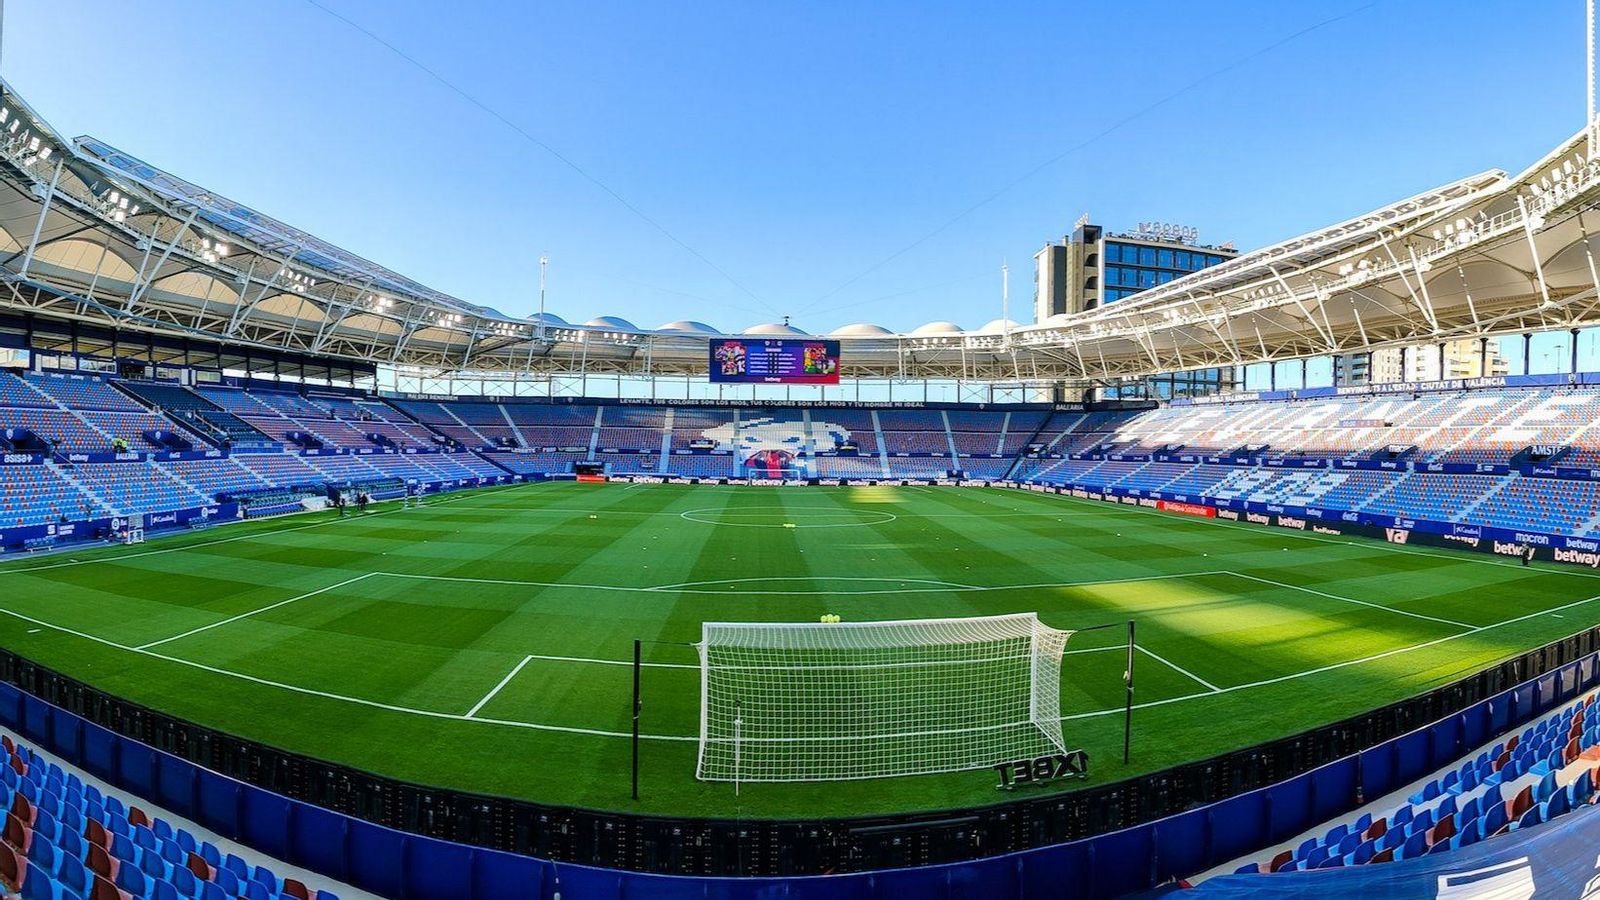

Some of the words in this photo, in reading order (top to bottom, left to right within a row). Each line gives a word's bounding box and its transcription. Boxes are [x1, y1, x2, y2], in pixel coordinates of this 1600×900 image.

[1421, 381, 1448, 390] CIUTAT
[1449, 379, 1463, 388] DE
[1464, 376, 1505, 387] VALÈNCIA
[1278, 516, 1306, 530] betway
[1515, 532, 1549, 544] macron
[1566, 538, 1598, 552] betway
[1494, 541, 1535, 560] betwy
[1554, 548, 1600, 568] betway
